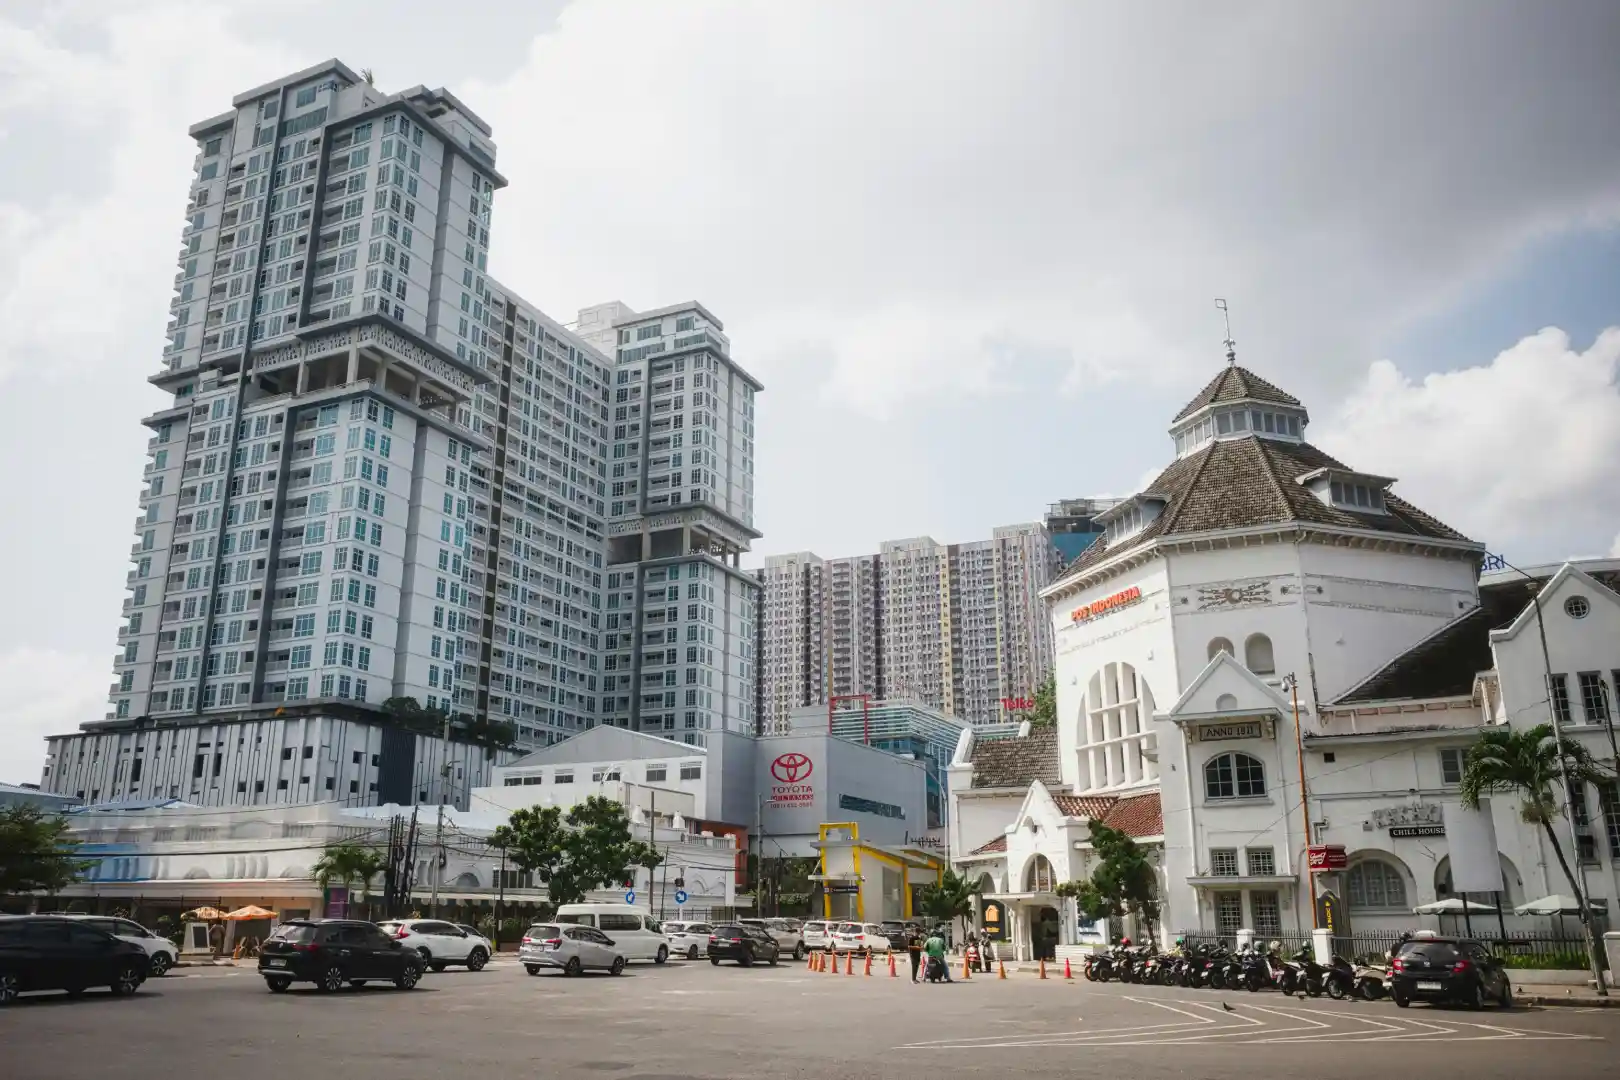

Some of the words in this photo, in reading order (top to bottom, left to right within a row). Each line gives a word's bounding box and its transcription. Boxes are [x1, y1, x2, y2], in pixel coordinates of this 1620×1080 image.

[1090, 586, 1142, 614] INDONESIA
[1206, 727, 1233, 737] ANNO
[772, 785, 812, 793] TOYOTA
[1418, 827, 1445, 835] HOUSE
